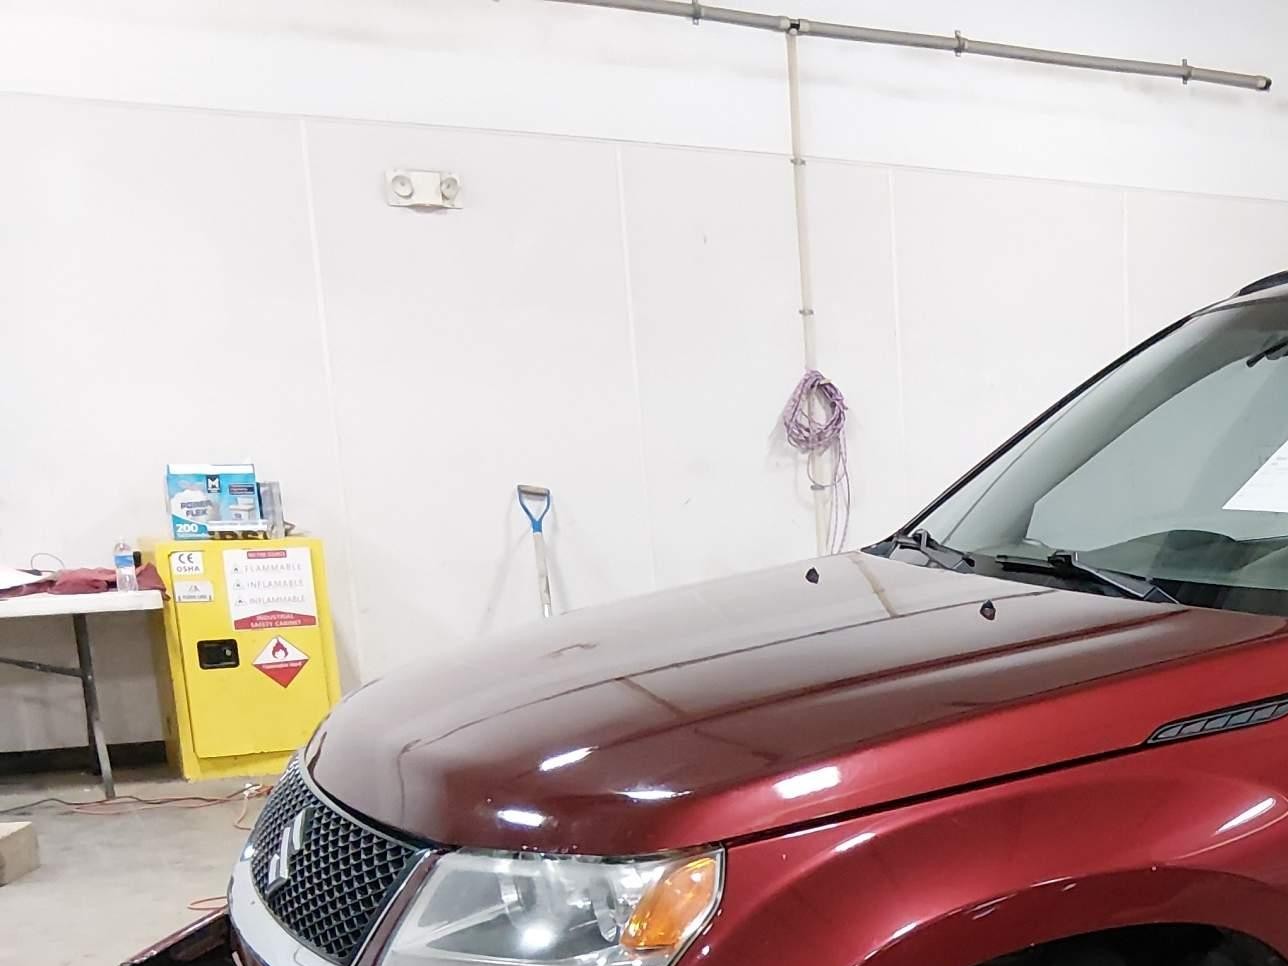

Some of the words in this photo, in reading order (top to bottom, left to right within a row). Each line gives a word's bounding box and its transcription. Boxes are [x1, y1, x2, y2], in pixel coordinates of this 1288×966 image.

[176, 524, 198, 532] 200
[245, 563, 301, 573] FLAMMABLE
[256, 613, 296, 621] INDUSTRIAL
[250, 621, 273, 629] SAFETY
[275, 618, 302, 626] CABINET
